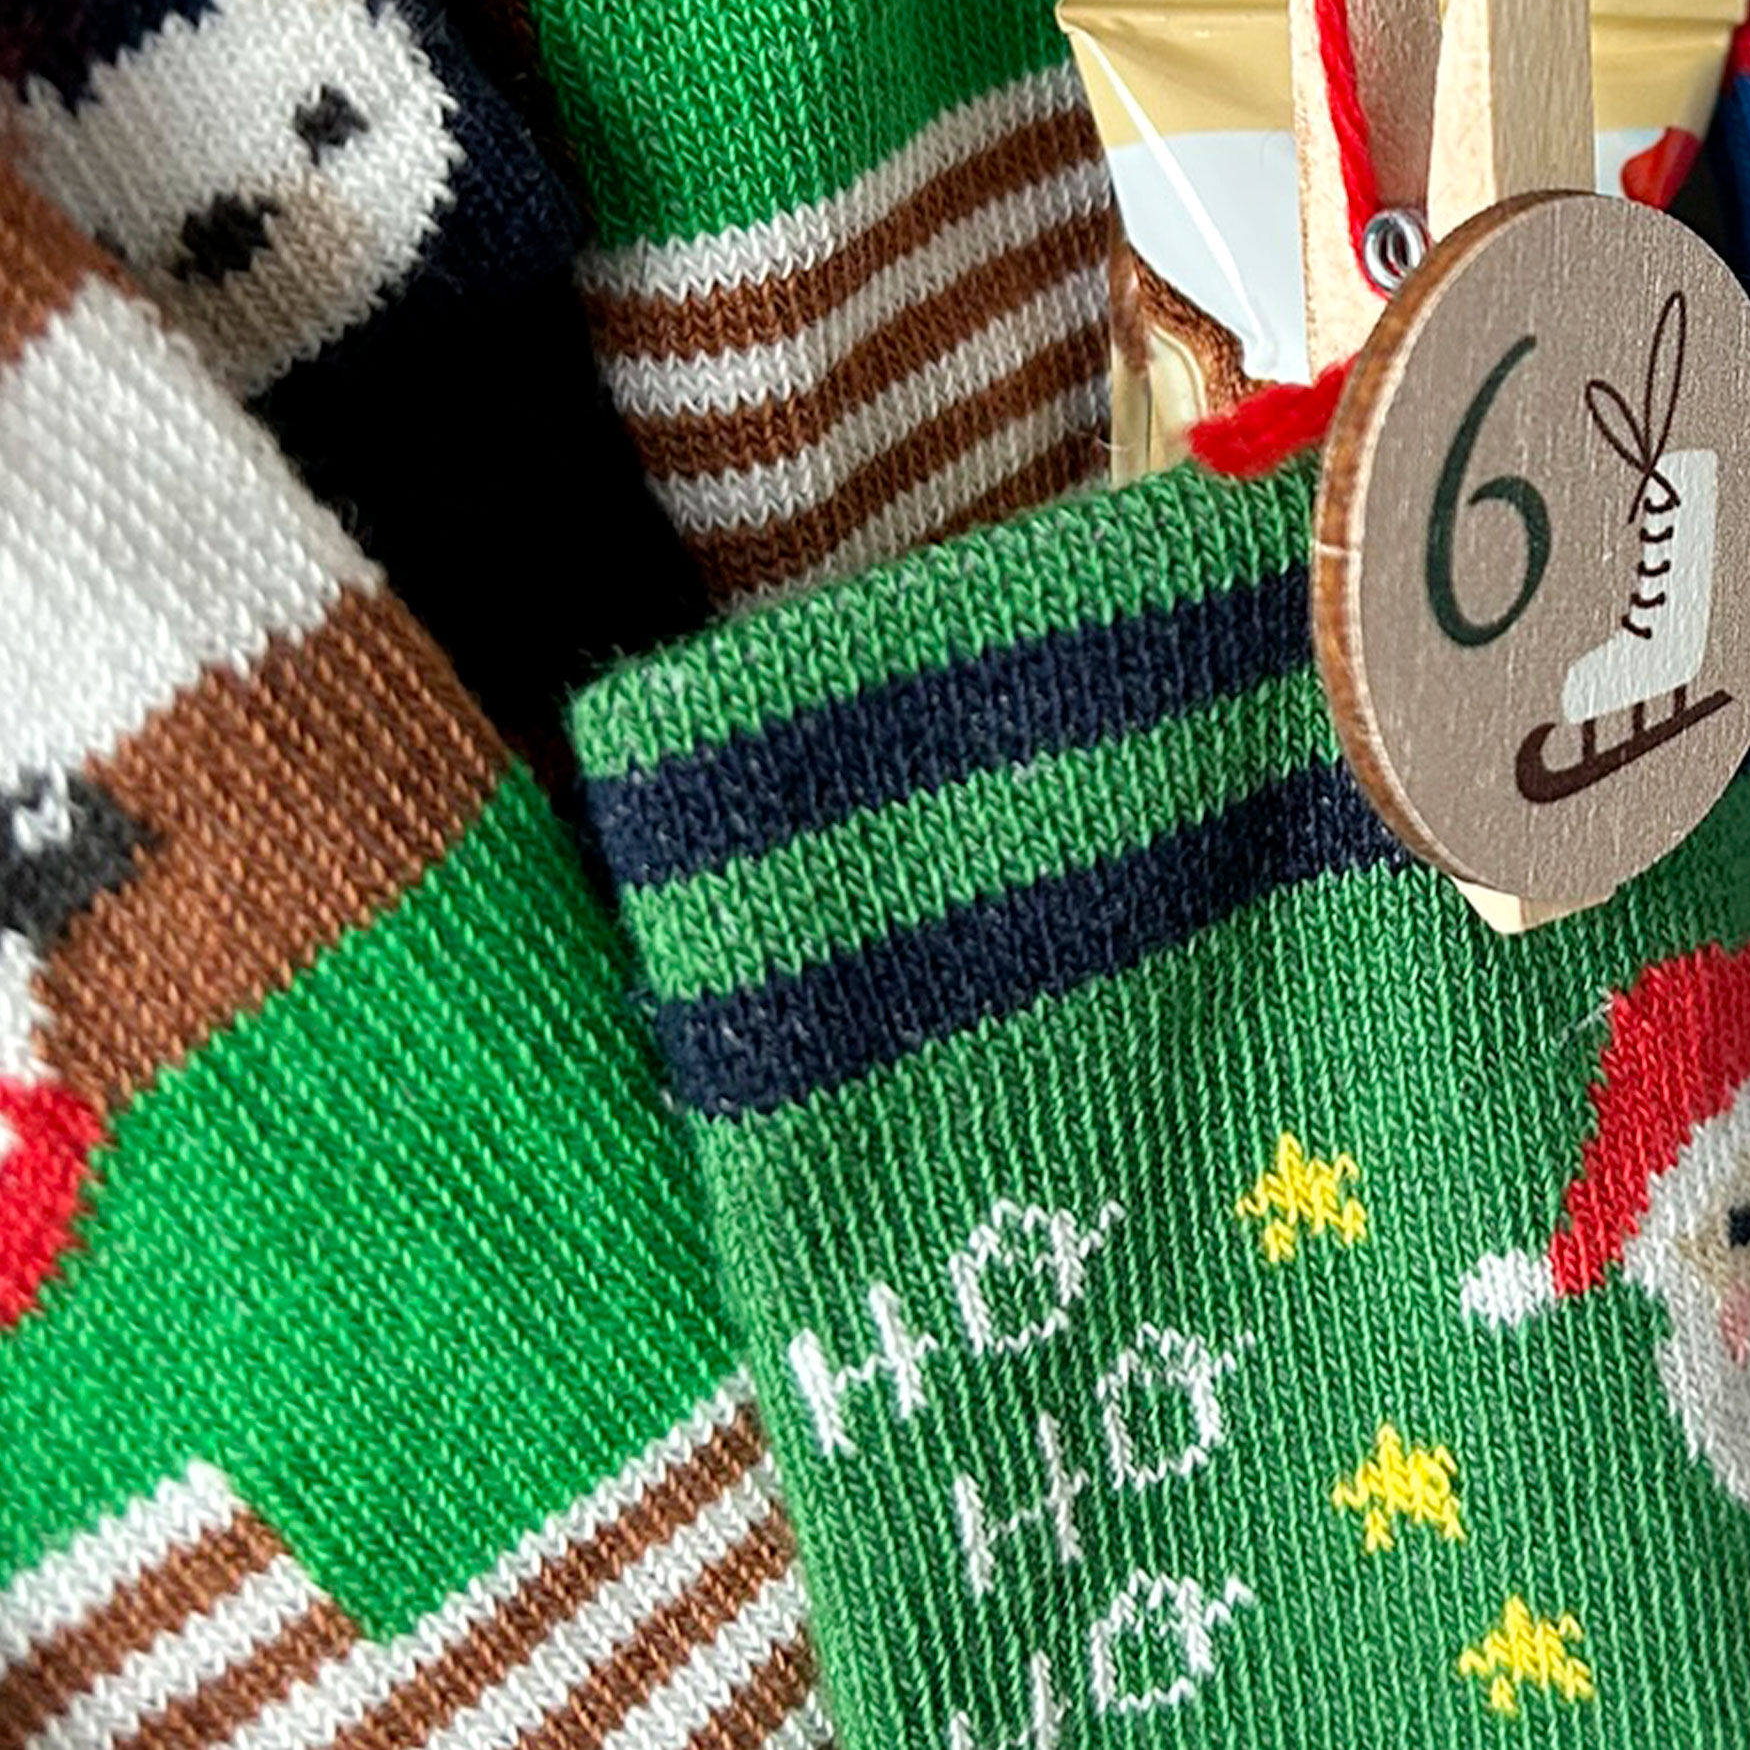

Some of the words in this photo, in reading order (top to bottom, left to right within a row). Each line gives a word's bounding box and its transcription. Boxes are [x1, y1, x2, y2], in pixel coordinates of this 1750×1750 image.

[1425, 334, 1552, 648] 6
[790, 1198, 1125, 1454] HO
[953, 1322, 1256, 1602] HO
